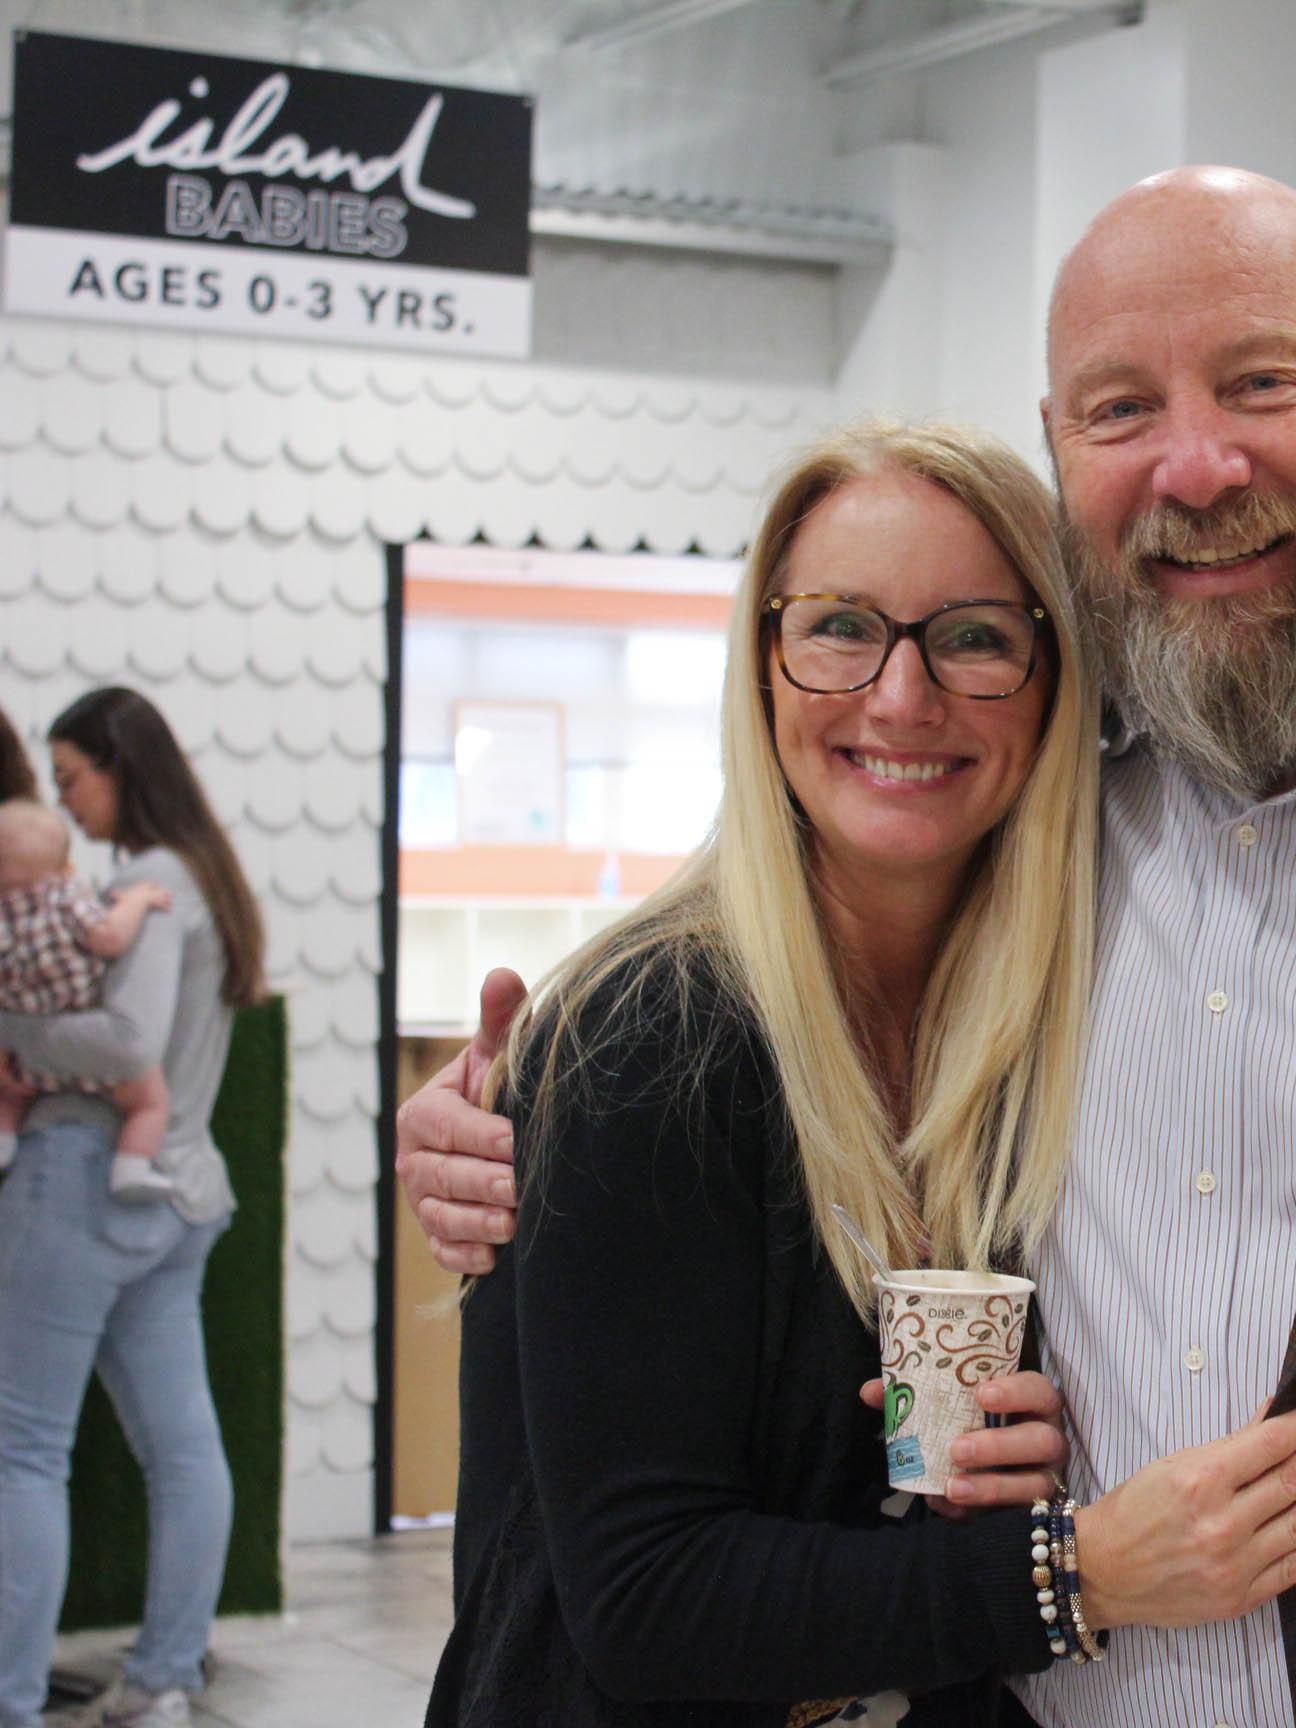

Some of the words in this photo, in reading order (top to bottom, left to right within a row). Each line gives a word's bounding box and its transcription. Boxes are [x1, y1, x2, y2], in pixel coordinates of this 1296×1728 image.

[76, 72, 476, 219] island
[165, 172, 409, 259] BABIES
[69, 259, 222, 310] AGES
[249, 275, 334, 321] 0-3
[357, 285, 476, 335] YRS.
